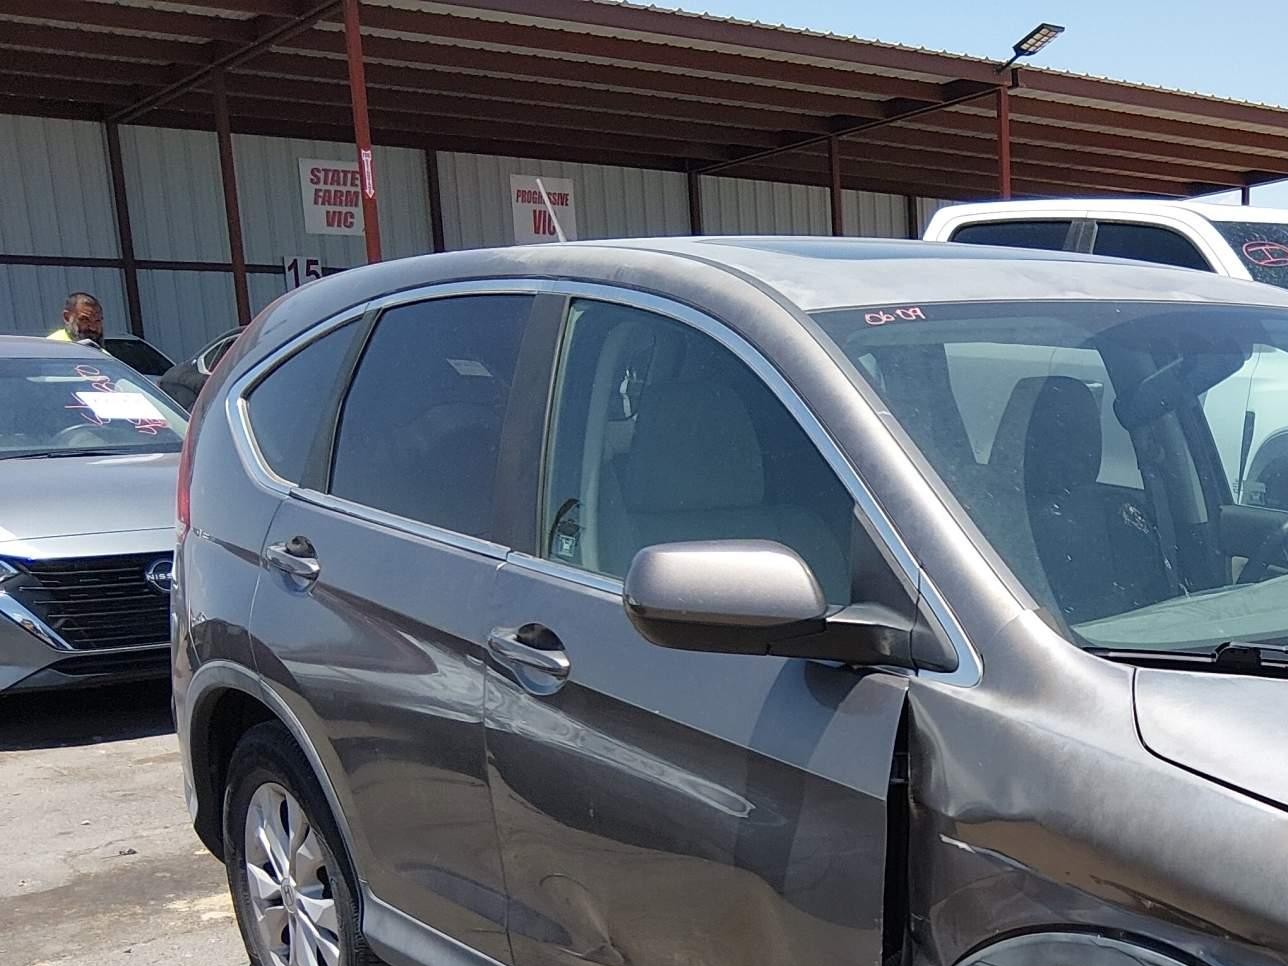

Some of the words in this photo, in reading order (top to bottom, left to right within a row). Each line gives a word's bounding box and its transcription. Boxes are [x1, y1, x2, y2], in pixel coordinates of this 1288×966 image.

[309, 167, 360, 188] STATE
[313, 188, 360, 208] FARM
[325, 210, 355, 229] VIC
[287, 258, 321, 289] 15
